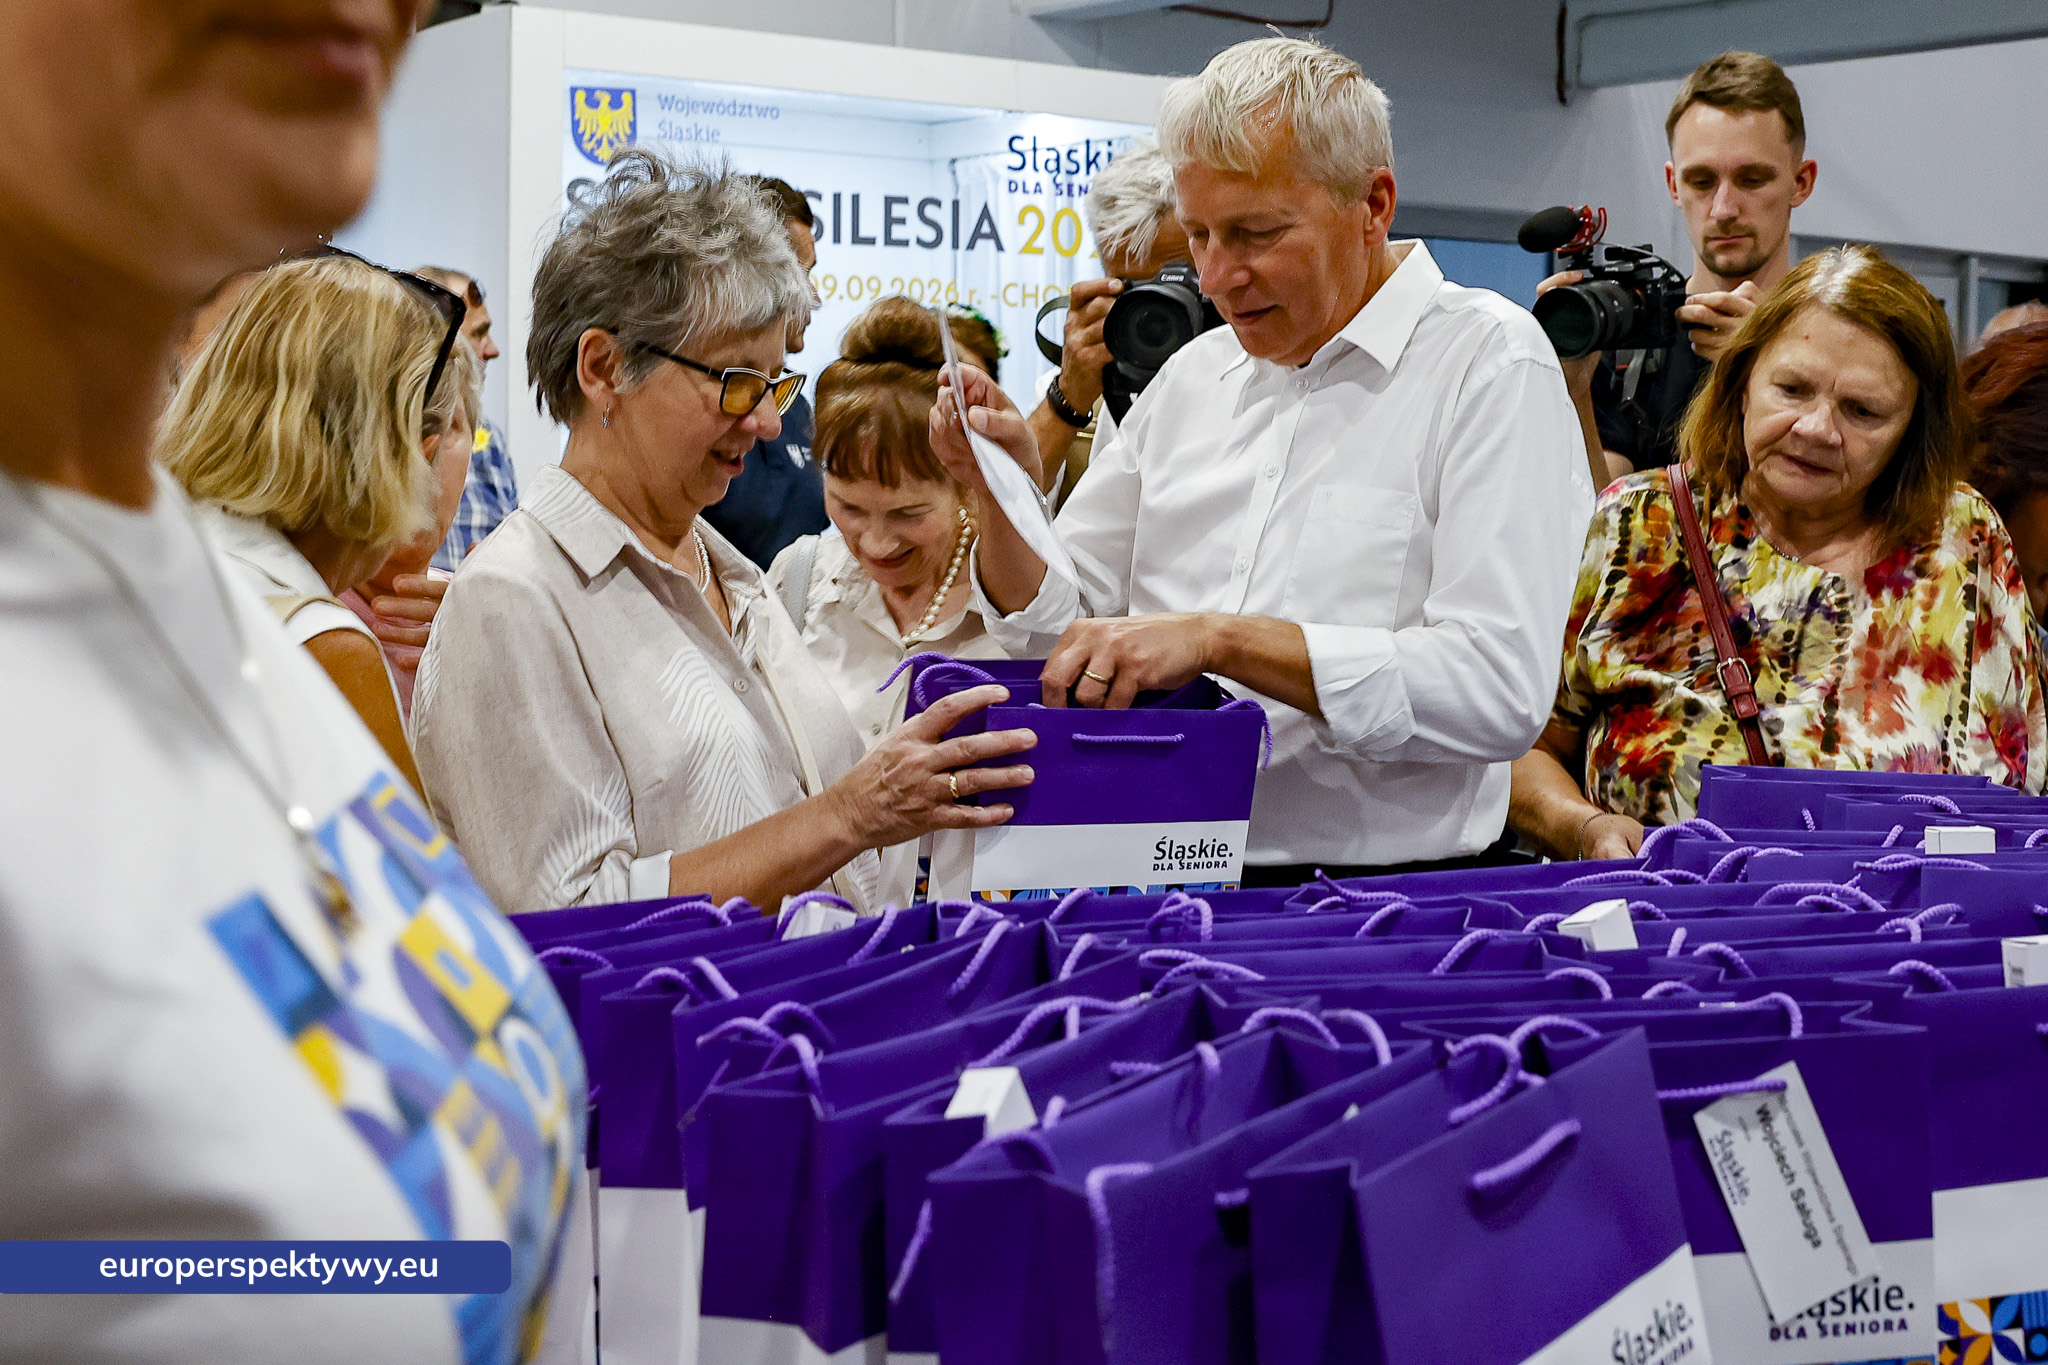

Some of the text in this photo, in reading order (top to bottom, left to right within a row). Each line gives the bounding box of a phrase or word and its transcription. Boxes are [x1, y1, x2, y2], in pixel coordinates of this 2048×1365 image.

[657, 92, 781, 120] Województwo
[657, 117, 721, 143] Śląskie
[1007, 179, 1090, 198] DLA SEN
[1017, 204, 1100, 259] 20
[1153, 835, 1234, 867] Śląskie.
[1152, 860, 1228, 872] DLA SENIORA
[1768, 1275, 1915, 1329] ąskie.
[1769, 1318, 1908, 1342] DLA SENIORA
